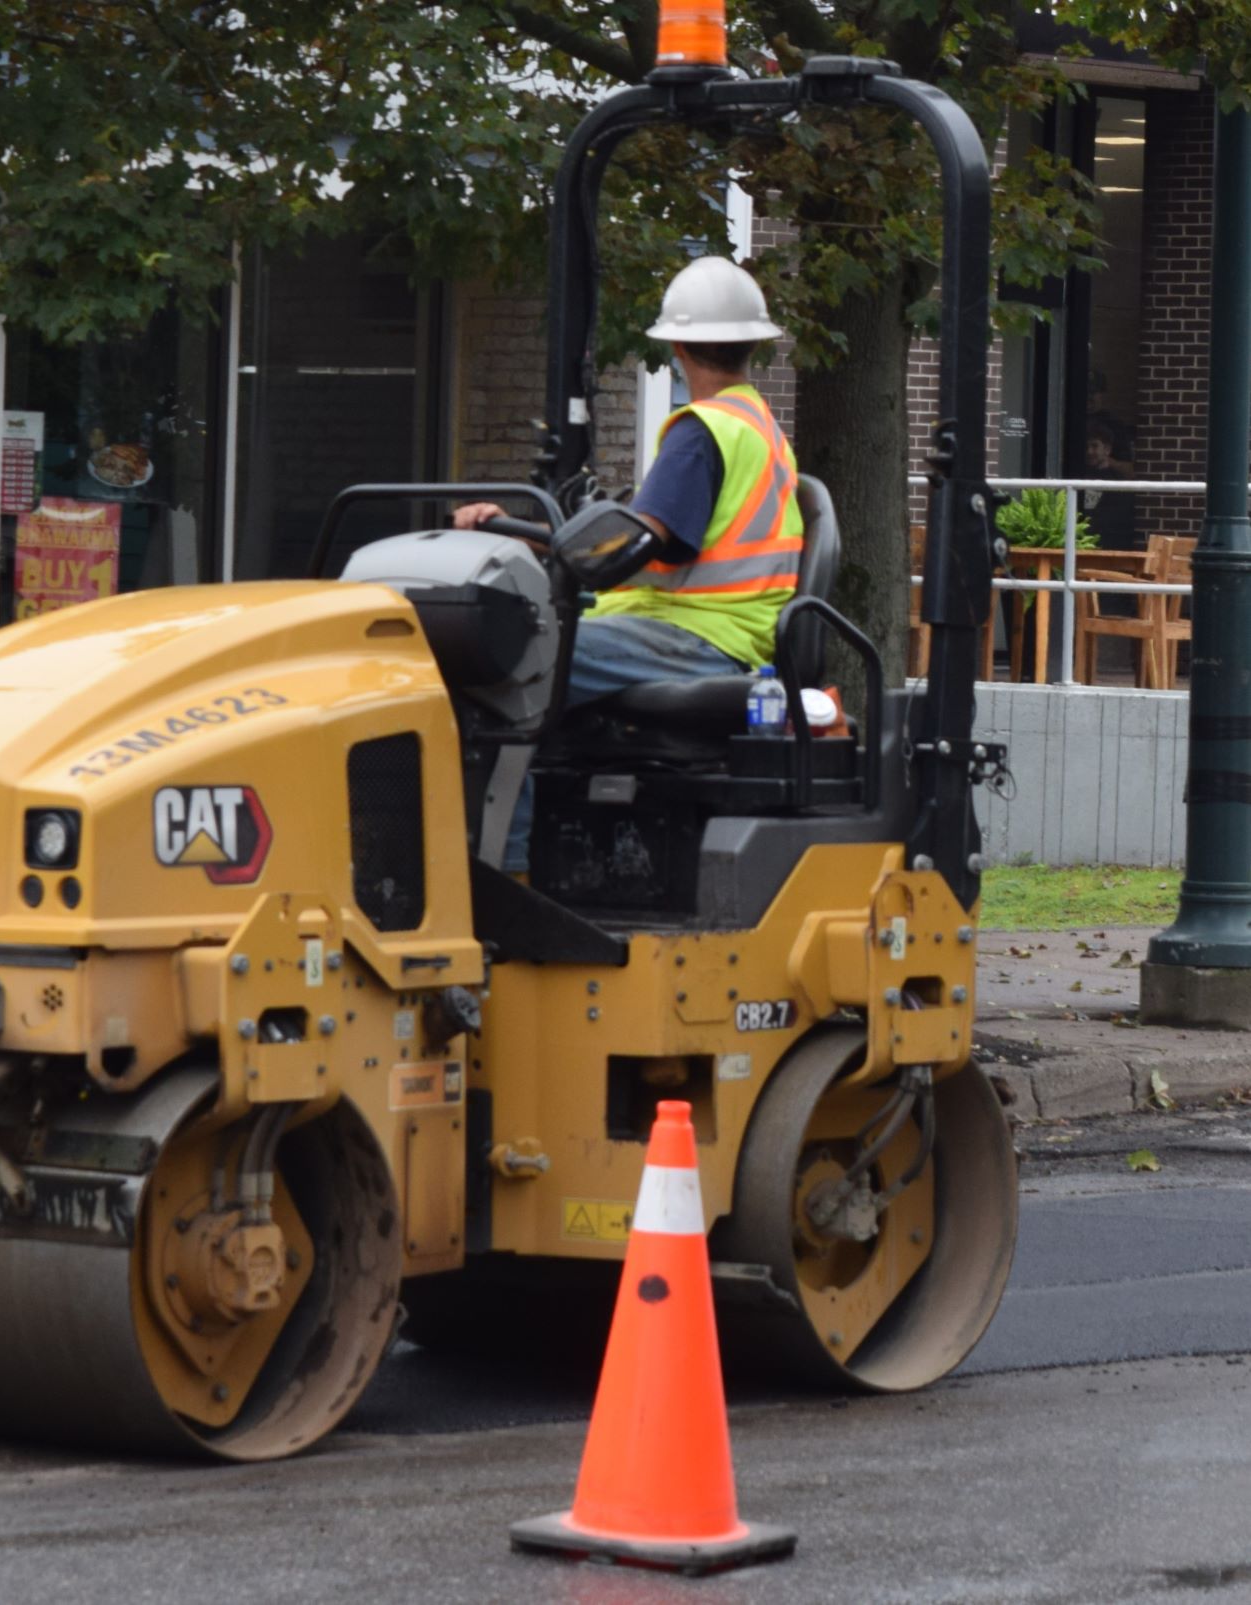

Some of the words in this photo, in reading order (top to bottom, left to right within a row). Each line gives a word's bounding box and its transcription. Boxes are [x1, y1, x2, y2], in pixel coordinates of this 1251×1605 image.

[22, 557, 85, 590] BUY
[88, 557, 112, 598] 1
[69, 687, 288, 777] 13M4623
[154, 787, 243, 863] CAT
[736, 1001, 789, 1031] CB2.7
